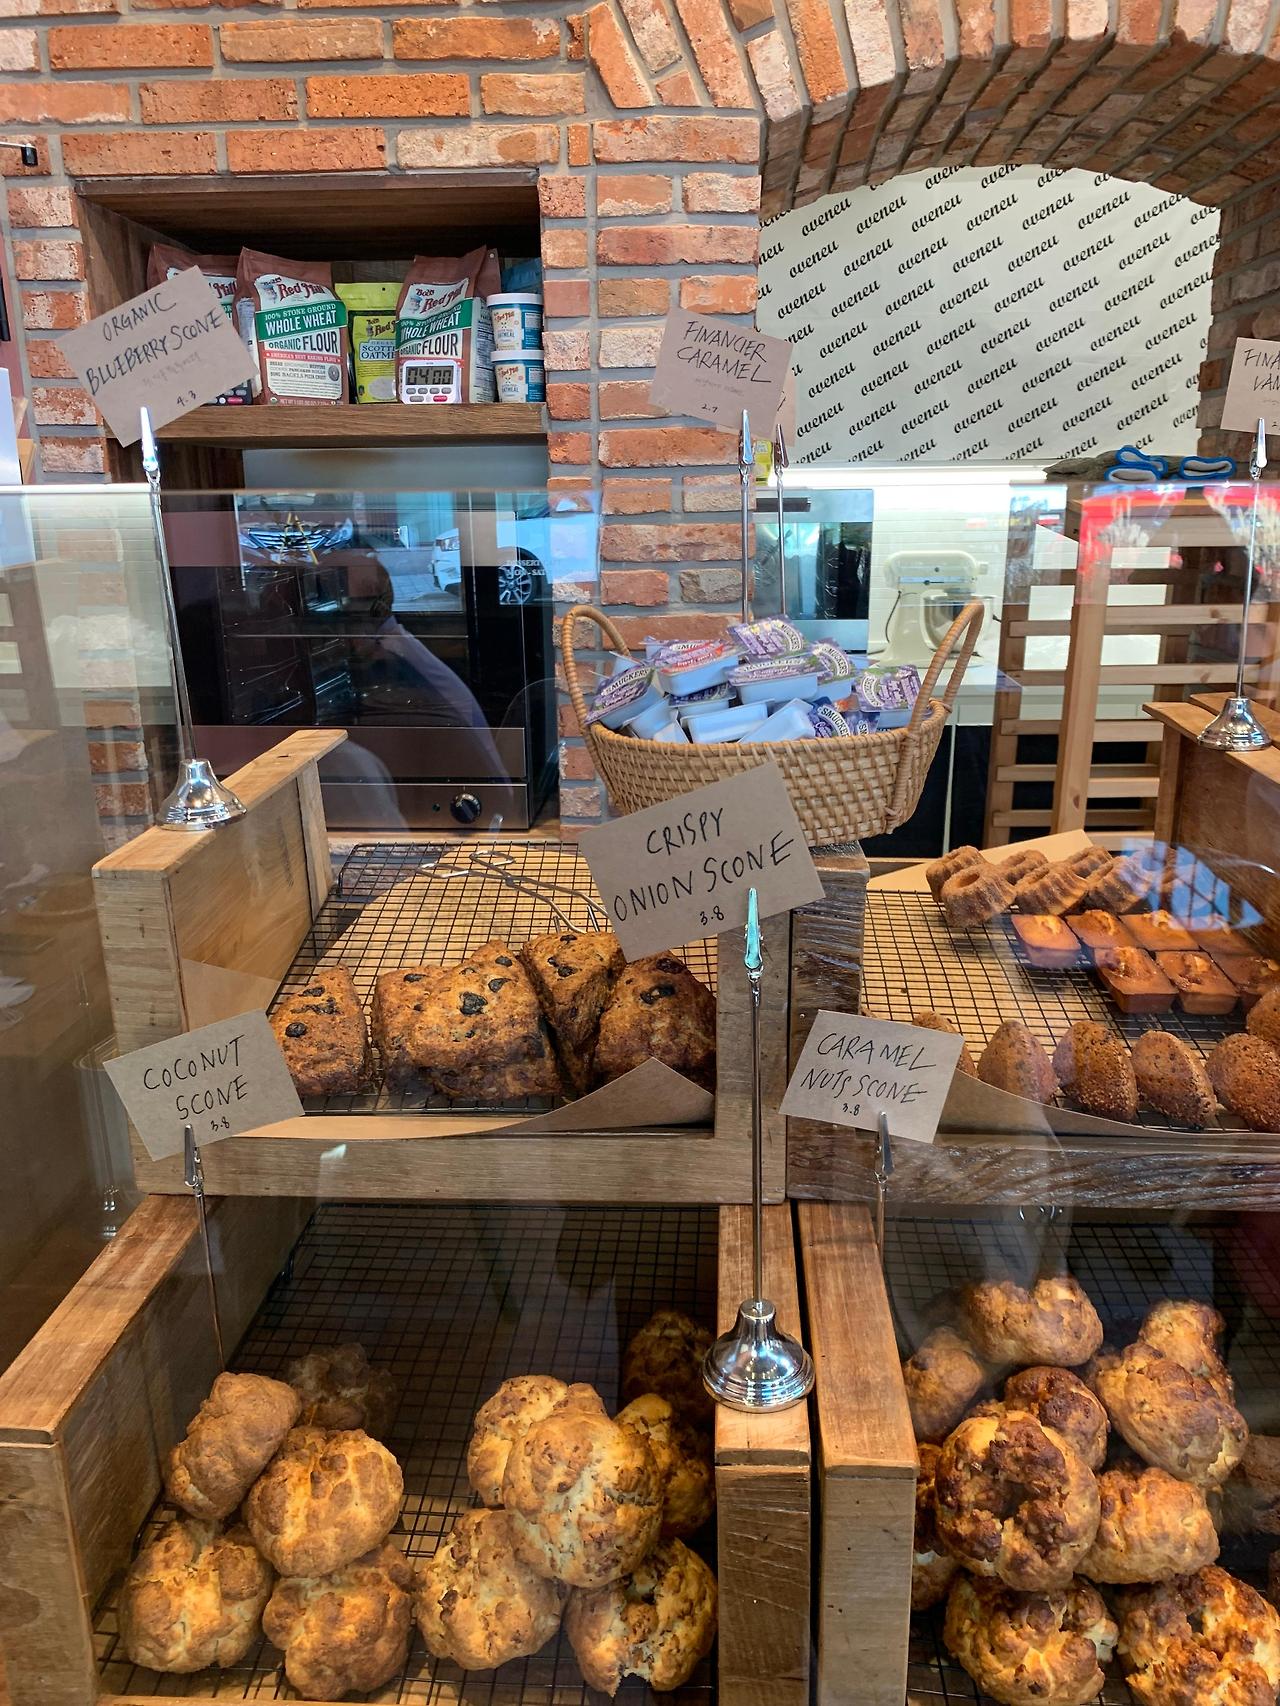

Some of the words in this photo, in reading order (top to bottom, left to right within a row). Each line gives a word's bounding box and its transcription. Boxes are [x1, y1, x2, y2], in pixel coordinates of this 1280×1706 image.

[801, 197, 852, 236] oveneu
[856, 196, 907, 234] oveneu
[911, 194, 962, 232] oveneu
[966, 193, 1018, 231] oveneu
[1022, 192, 1074, 230] oveneu
[1078, 191, 1130, 229] oveneu
[789, 240, 839, 278] oveneu
[843, 238, 894, 276] oveneu
[898, 237, 948, 274] oveneu
[952, 236, 1003, 272] oveneu
[1008, 235, 1058, 272] oveneu
[1063, 234, 1114, 271] oveneu
[1118, 232, 1170, 269] oveneu
[277, 283, 302, 301] Red
[420, 293, 447, 314] Red
[777, 282, 827, 319] oveneu
[831, 280, 881, 317] oveneu
[885, 279, 934, 315] oveneu
[939, 277, 989, 314] oveneu
[994, 277, 1044, 312] oveneu
[1049, 276, 1099, 312] oveneu
[1104, 274, 1155, 311] oveneu
[1159, 271, 1210, 309] oveneu
[102, 292, 177, 342] ORGANIC
[265, 316, 302, 337] WHOLE
[303, 309, 337, 329] WHEAT
[283, 307, 306, 318] STONE
[307, 303, 337, 313] GROUND
[429, 311, 461, 333] WHEAT
[268, 336, 301, 351] ORGANIC
[302, 330, 339, 354] FLOUR
[422, 333, 458, 356] FLOUR
[683, 320, 767, 363] FINANCIER
[819, 321, 868, 358] oveneu
[872, 320, 922, 356] oveneu
[926, 318, 977, 354] oveneu
[980, 318, 1031, 353] oveneu
[1035, 317, 1085, 352] oveneu
[1090, 316, 1140, 351] oveneu
[1145, 313, 1197, 349] oveneu
[86, 335, 168, 396] BLUEBERRY
[169, 307, 223, 351] SCONE
[677, 346, 772, 383] CARAMEL
[808, 362, 856, 398] oveneu
[861, 360, 910, 396] oveneu
[914, 359, 963, 394] oveneu
[967, 358, 1018, 393] oveneu
[1022, 357, 1072, 392] oveneu
[1076, 356, 1127, 391] oveneu
[1131, 353, 1182, 390] oveneu
[175, 389, 197, 407] 4.3
[701, 403, 718, 413] 2.7
[953, 398, 1004, 433] oveneu
[1007, 397, 1058, 432] oveneu
[1062, 396, 1113, 431] oveneu
[1116, 393, 1169, 430] oveneu
[796, 402, 845, 437] oveneu
[848, 400, 897, 435] oveneu
[901, 399, 950, 434] oveneu
[646, 807, 724, 856] CRISPY
[613, 870, 693, 922] ONION
[703, 830, 795, 893] SCONE
[699, 905, 725, 926] 3.8
[143, 1034, 245, 1090] COCONUT
[817, 1032, 937, 1071] CARAMEL
[176, 1074, 249, 1120] SCONE
[800, 1068, 852, 1099] NUTS
[852, 1074, 928, 1104] SCONE
[210, 1115, 231, 1132] 3.8
[842, 1102, 861, 1116] 3.8
